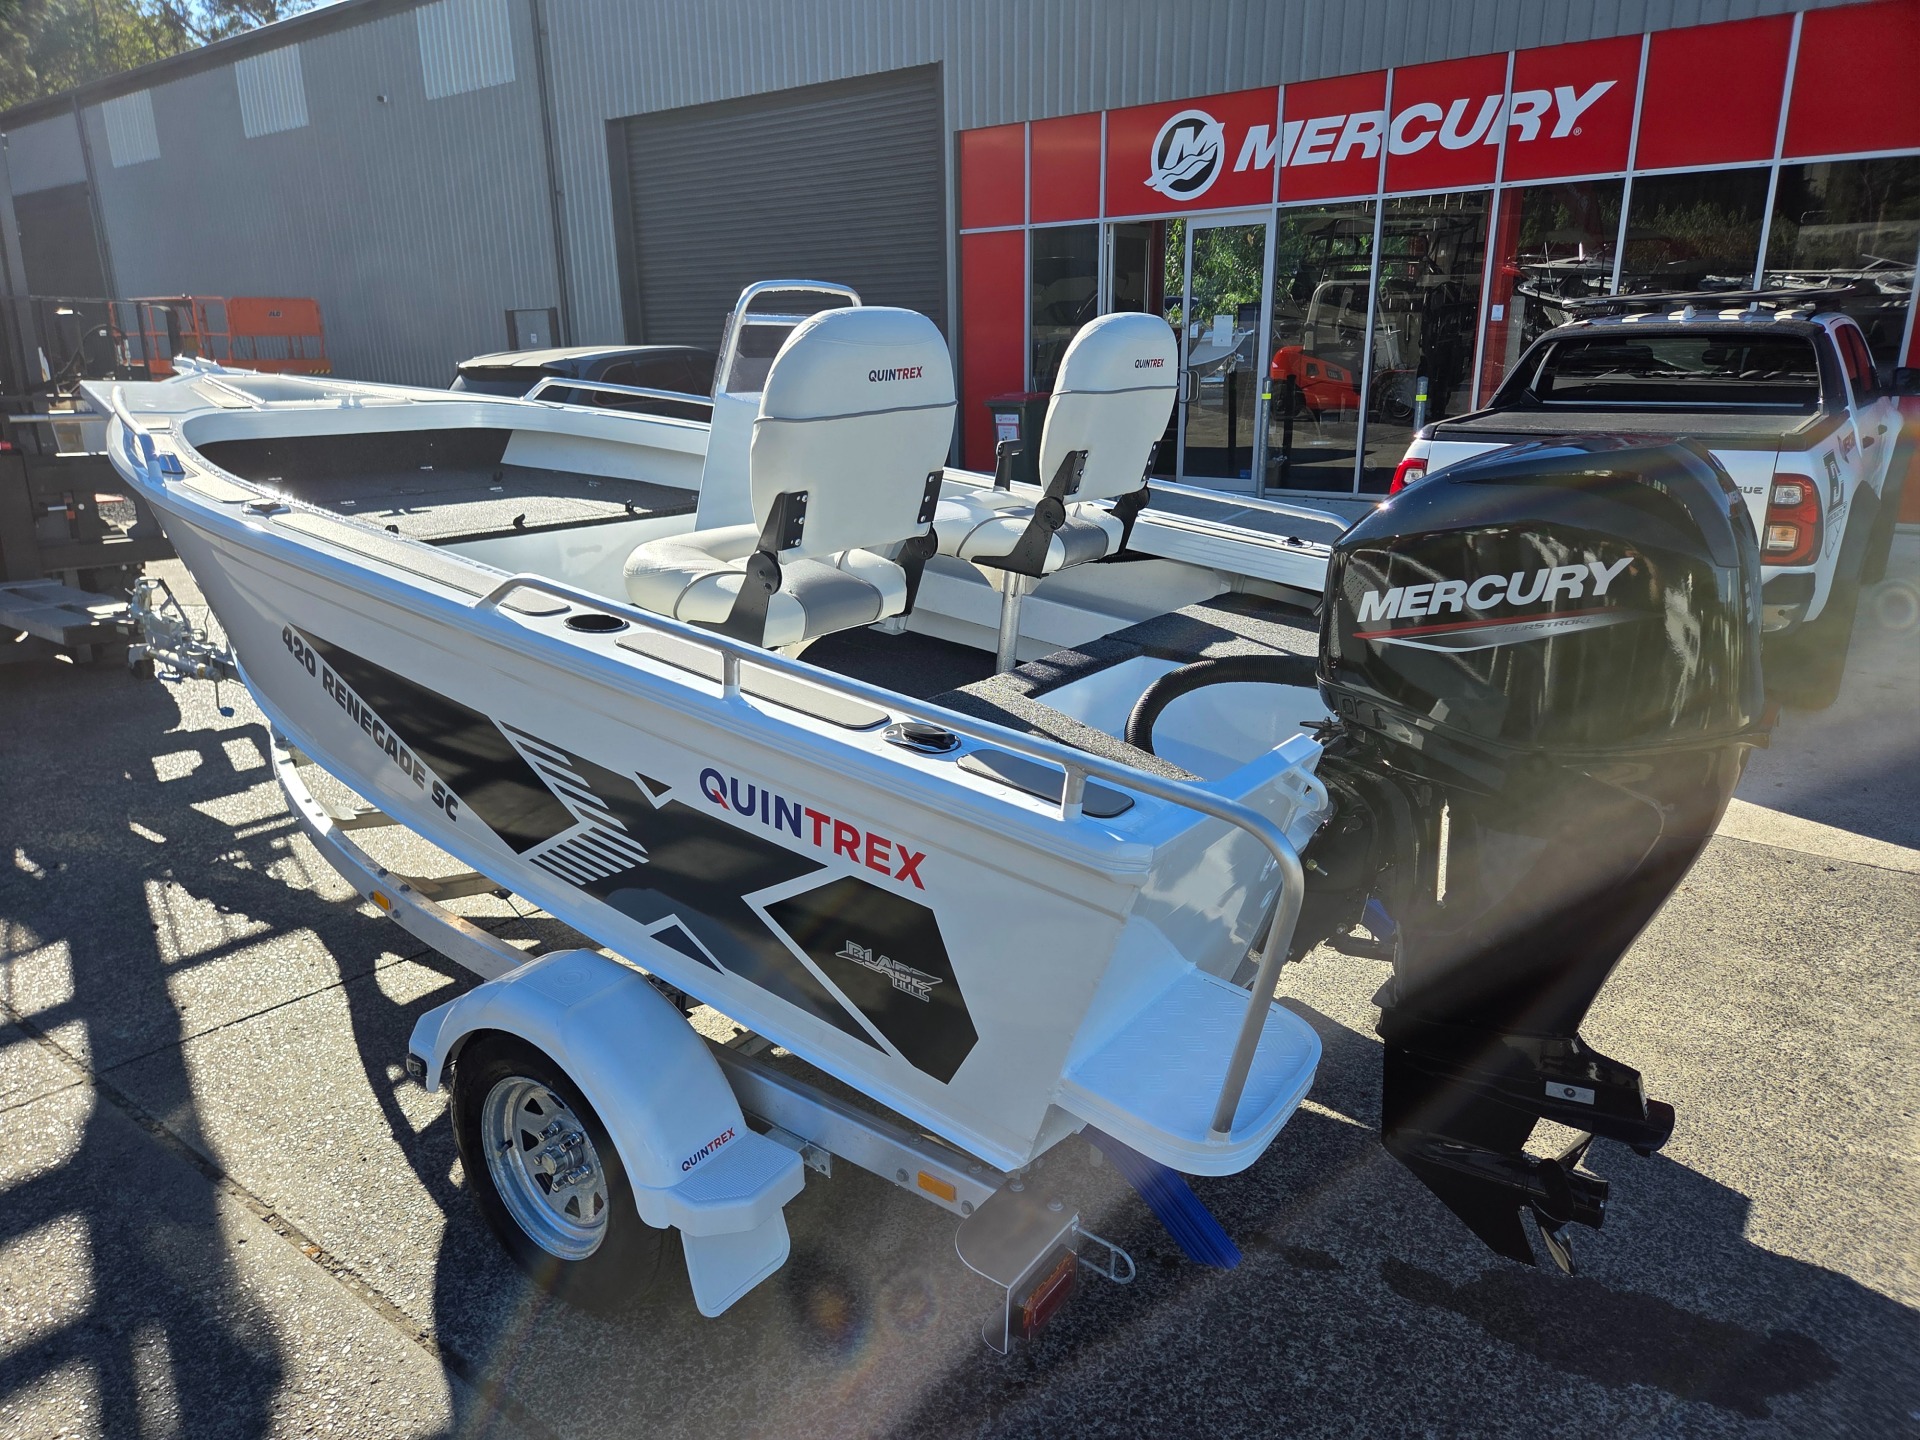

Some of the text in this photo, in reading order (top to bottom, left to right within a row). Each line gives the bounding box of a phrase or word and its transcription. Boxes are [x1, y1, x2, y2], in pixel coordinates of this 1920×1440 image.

[1233, 80, 1619, 173] MERCURY
[868, 366, 923, 383] QUINTREX
[1134, 358, 1165, 369] QUINTREX
[1356, 556, 1635, 623] MERCURY
[281, 625, 459, 822] 420 RENEGADE SC
[699, 767, 927, 891] QUINTREX
[835, 940, 943, 990] BLADE
[893, 978, 930, 1003] HULL
[681, 1126, 736, 1172] QUINTREX
